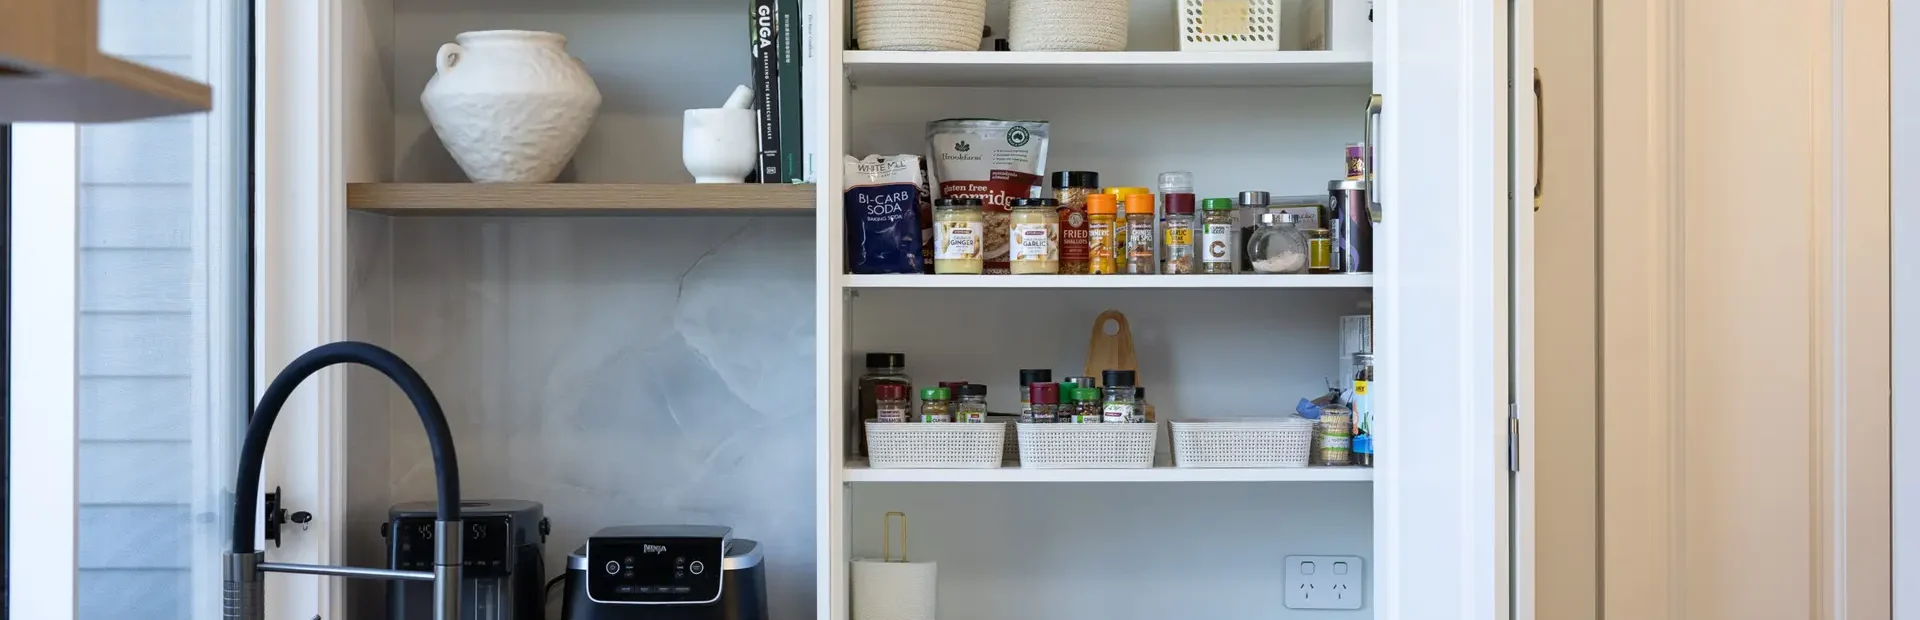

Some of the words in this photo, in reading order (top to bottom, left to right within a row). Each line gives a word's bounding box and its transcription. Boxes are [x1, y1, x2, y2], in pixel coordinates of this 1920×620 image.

[758, 5, 771, 48] GUGA
[858, 163, 886, 172] WHITE
[944, 184, 966, 194] gluten
[858, 191, 909, 205] BI-CARB
[950, 190, 1015, 210] rridg
[867, 203, 902, 215] SODA
[1063, 229, 1088, 239] FRIED
[1209, 240, 1226, 258] C
[418, 525, 433, 540] 45
